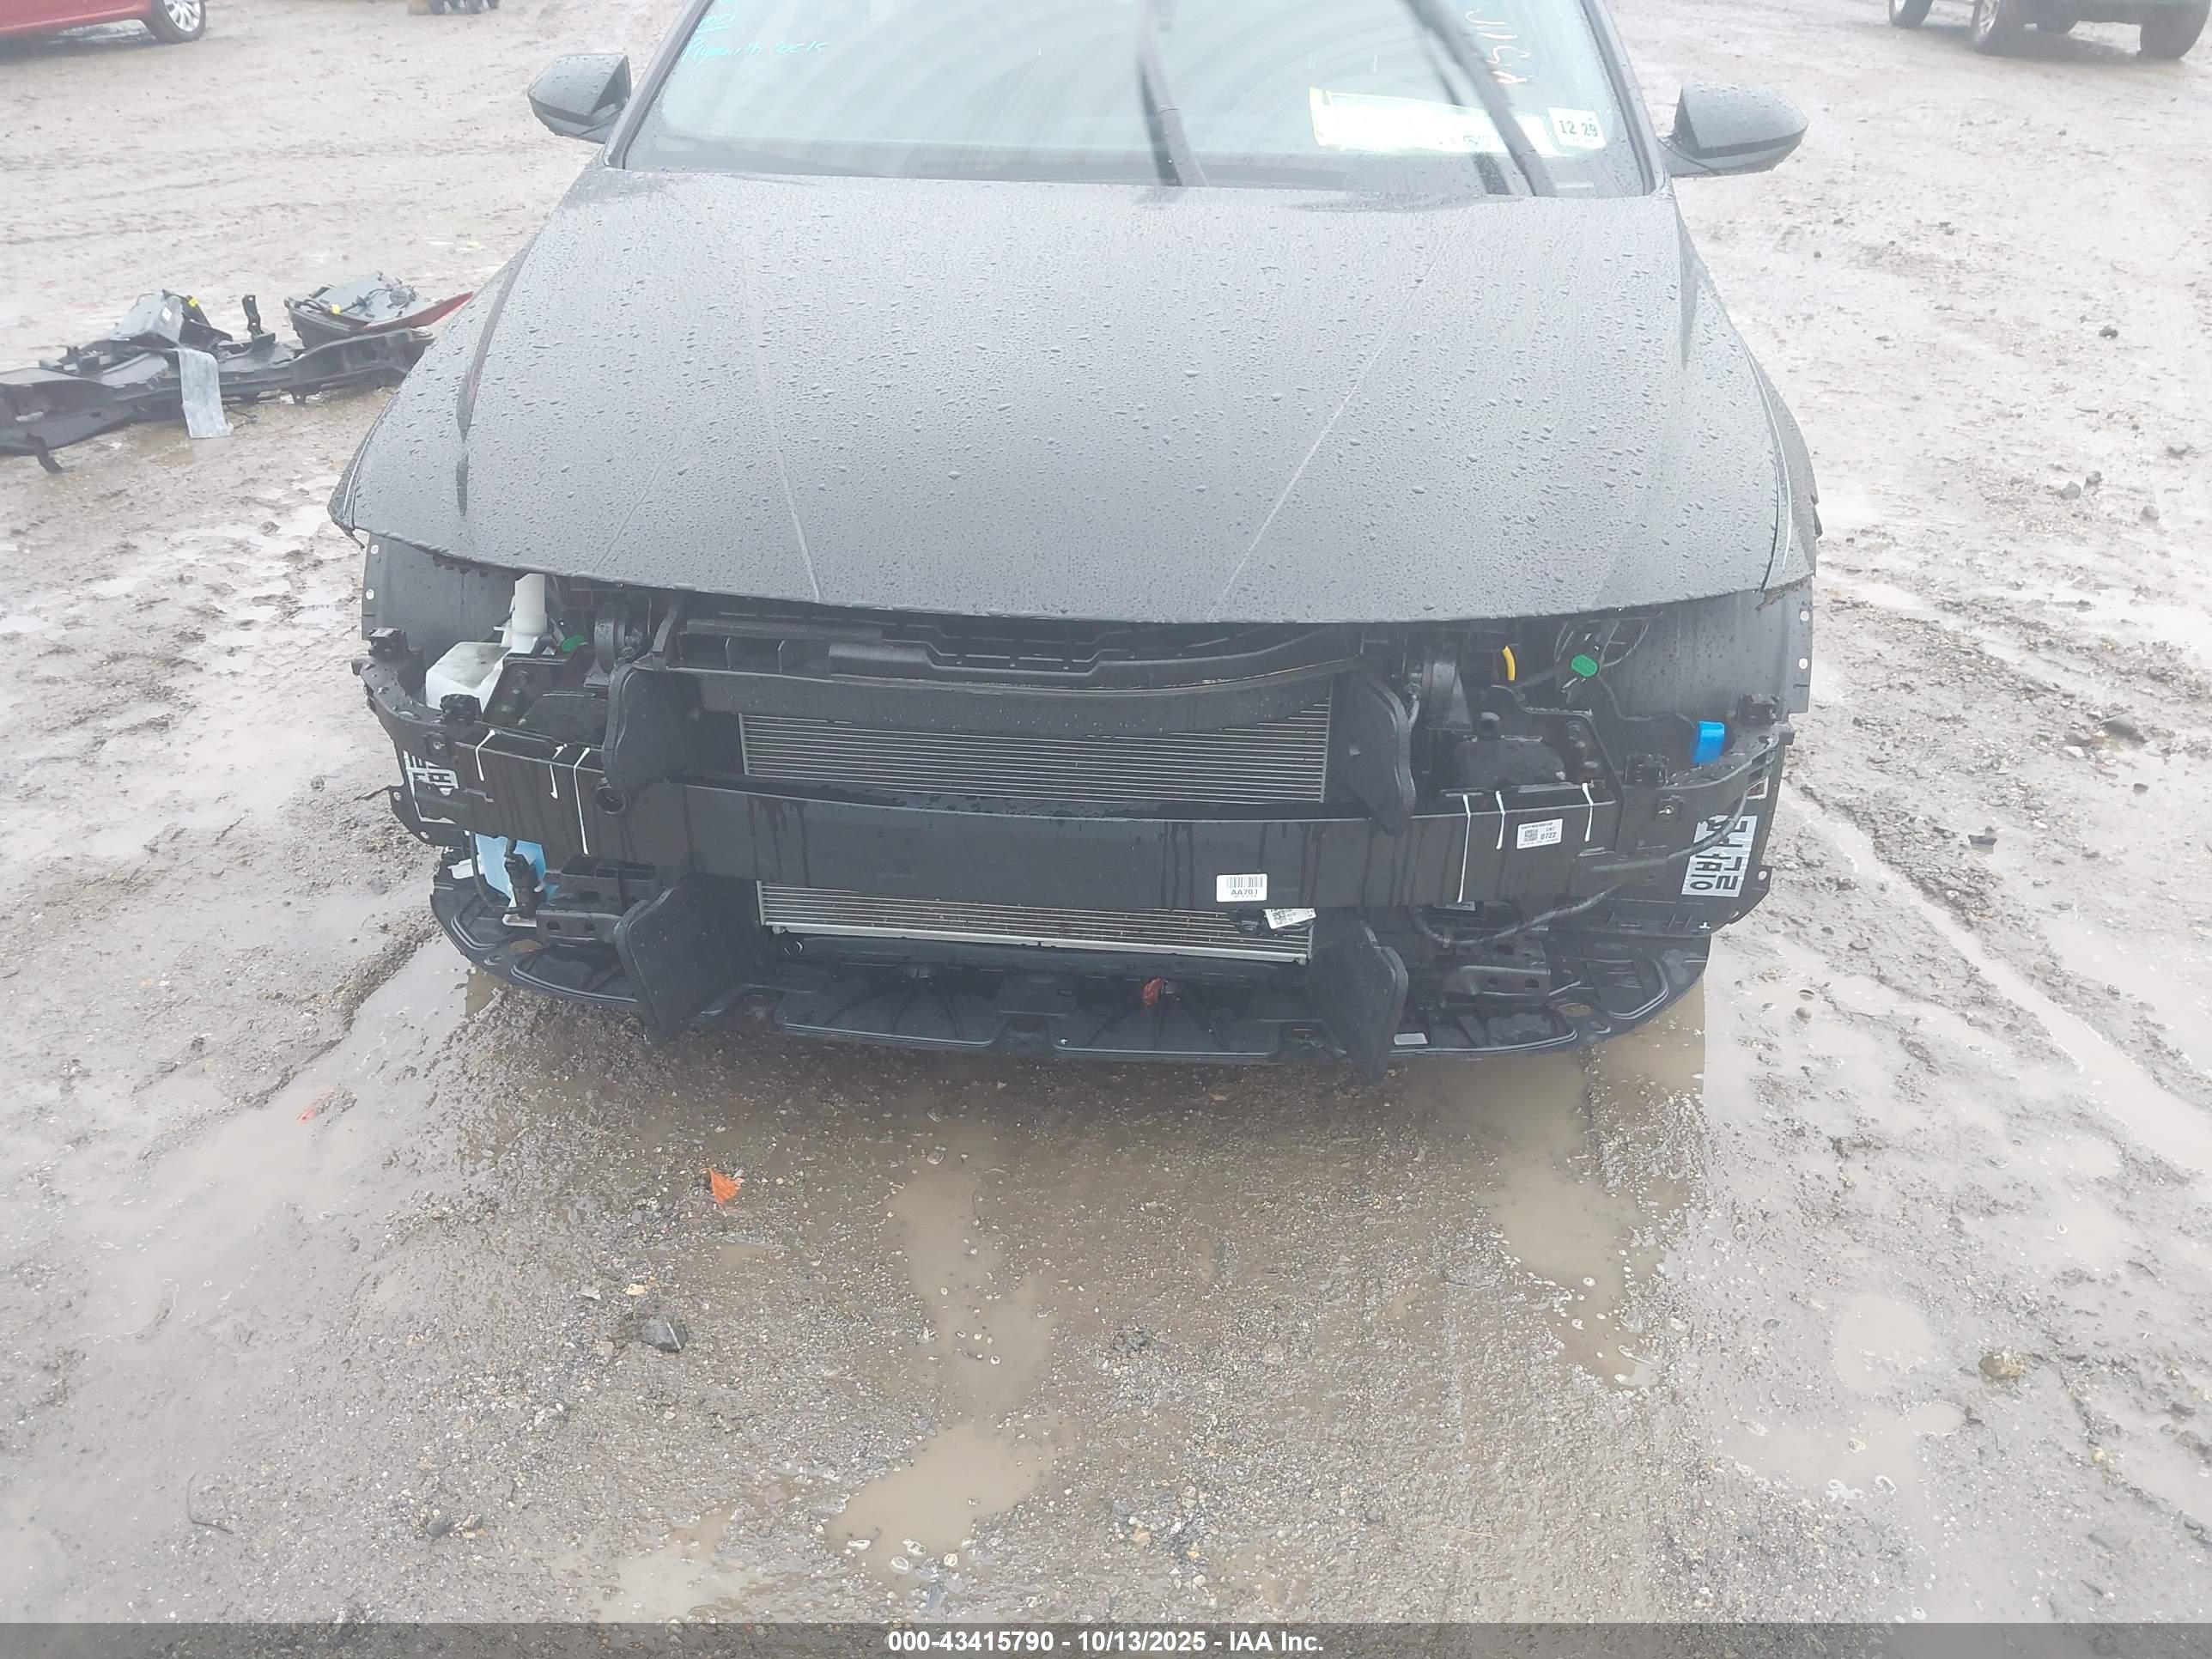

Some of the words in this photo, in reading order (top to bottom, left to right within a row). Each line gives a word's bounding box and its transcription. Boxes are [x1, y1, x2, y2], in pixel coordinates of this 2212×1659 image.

[1558, 119, 1577, 135] 12
[1580, 122, 1599, 137] 29
[1540, 831, 1557, 840] 0722
